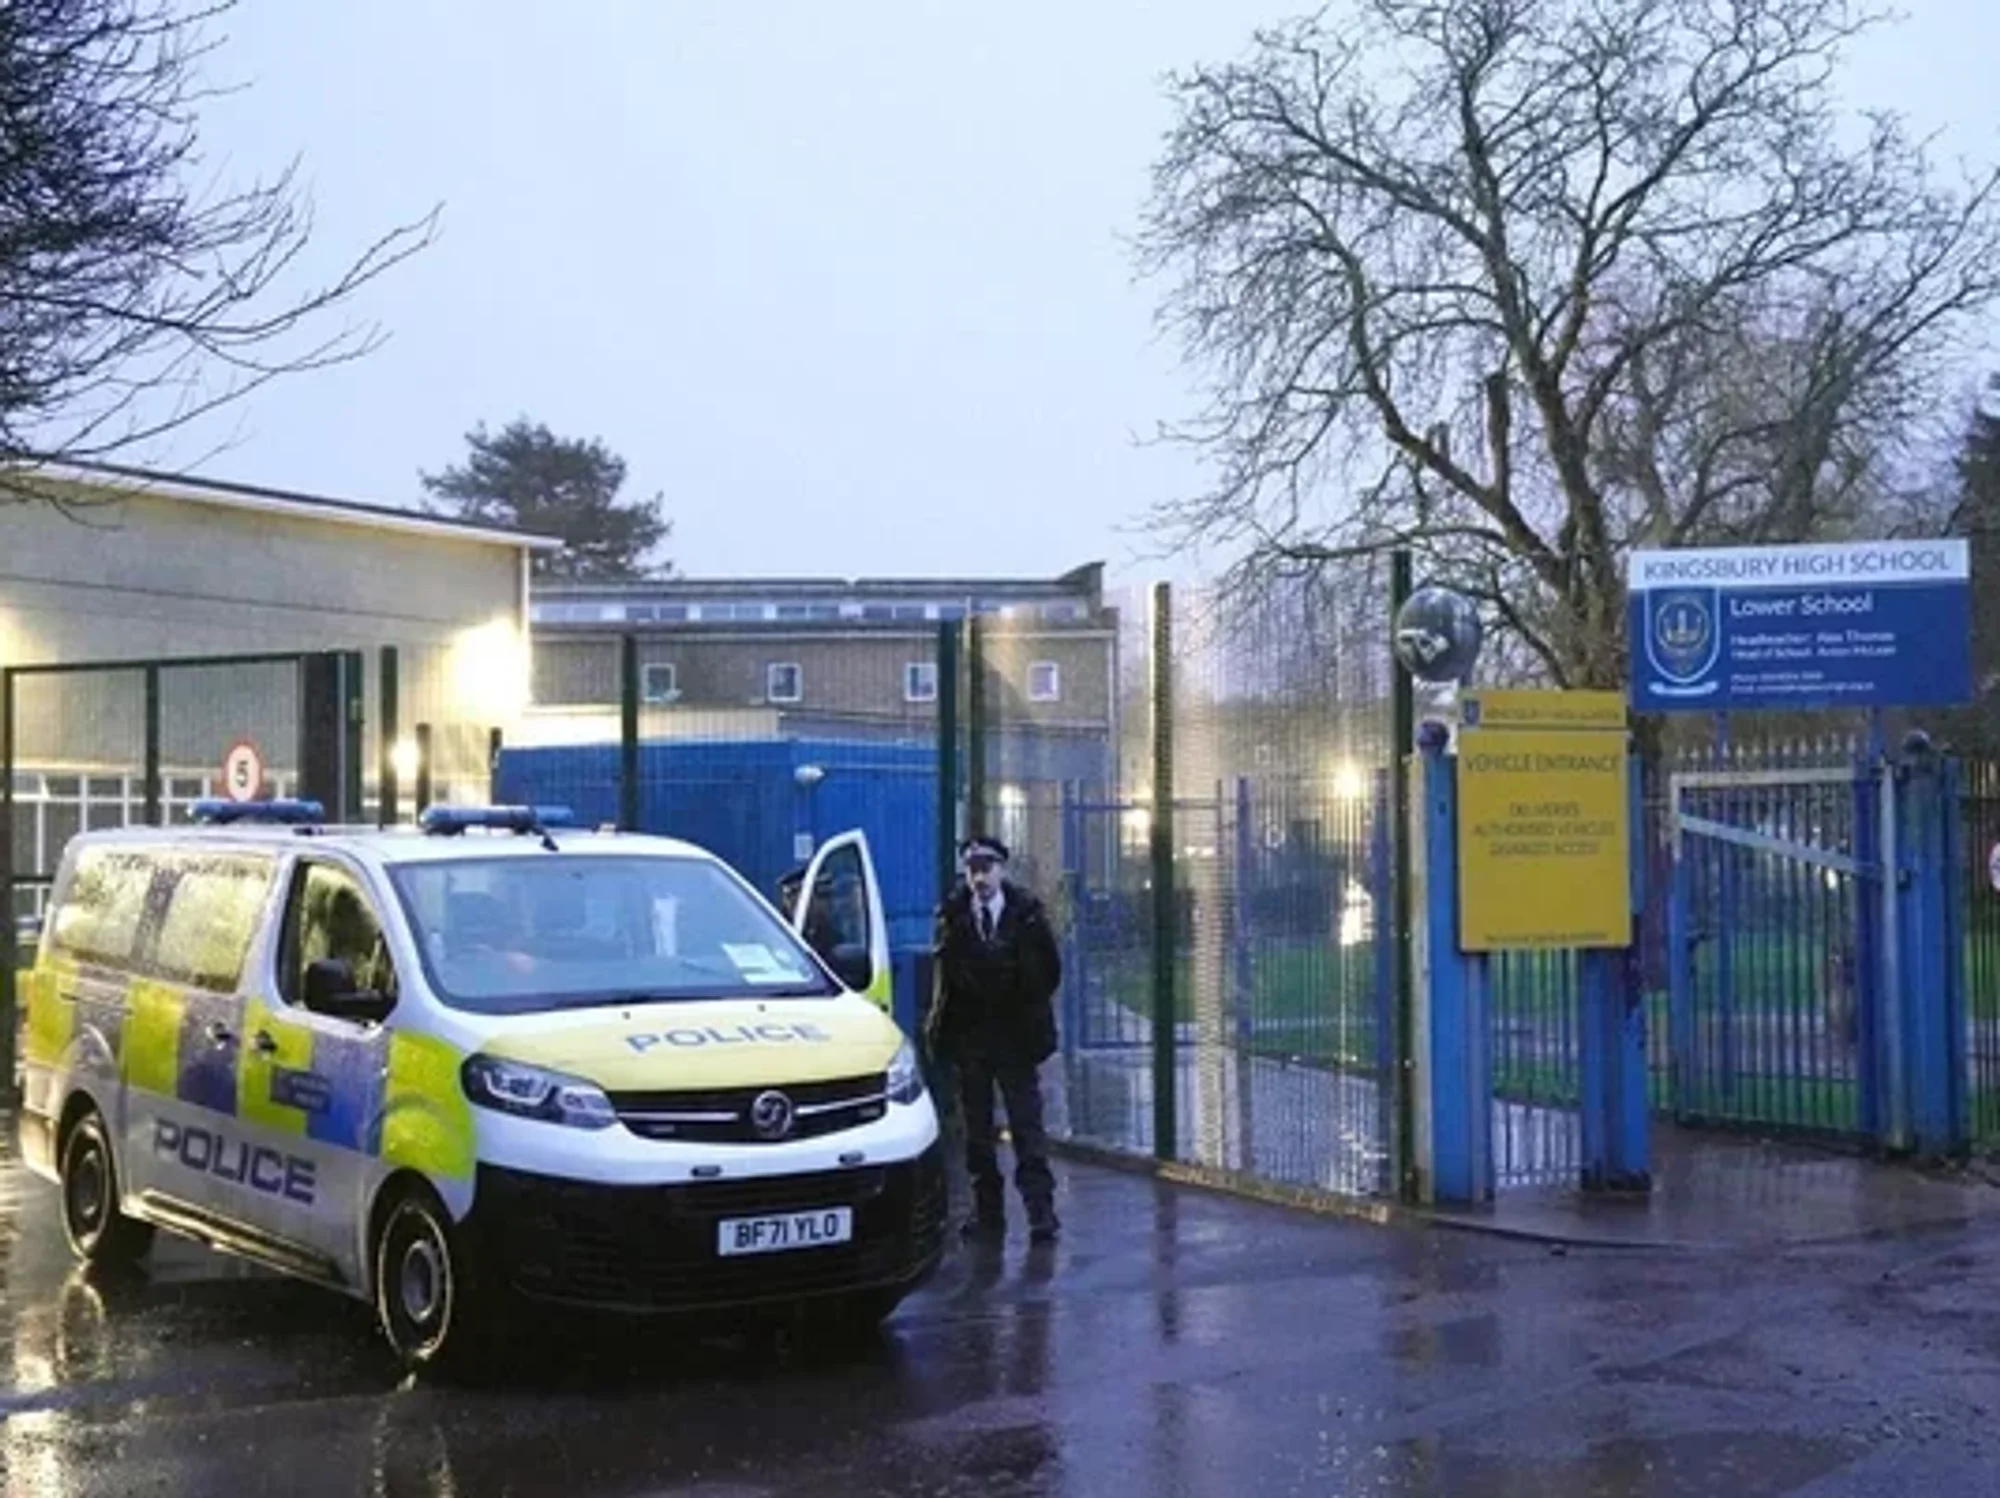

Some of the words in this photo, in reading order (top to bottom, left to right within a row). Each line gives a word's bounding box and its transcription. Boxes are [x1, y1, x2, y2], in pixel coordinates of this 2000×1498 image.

[1644, 555, 1777, 580] KINGSBURY
[1783, 553, 1844, 576] HIGH
[1850, 549, 1950, 572] SCHOOL
[1730, 598, 1796, 617] Lower
[1801, 591, 1874, 615] School
[236, 760, 249, 788] 5
[1465, 752, 1531, 773] VEHICLE
[1536, 751, 1620, 773] ENTRANCE
[625, 1023, 832, 1053] POLICE
[154, 1117, 317, 1206] POLICE
[734, 1219, 788, 1249] BF71
[794, 1213, 840, 1241] YLO
